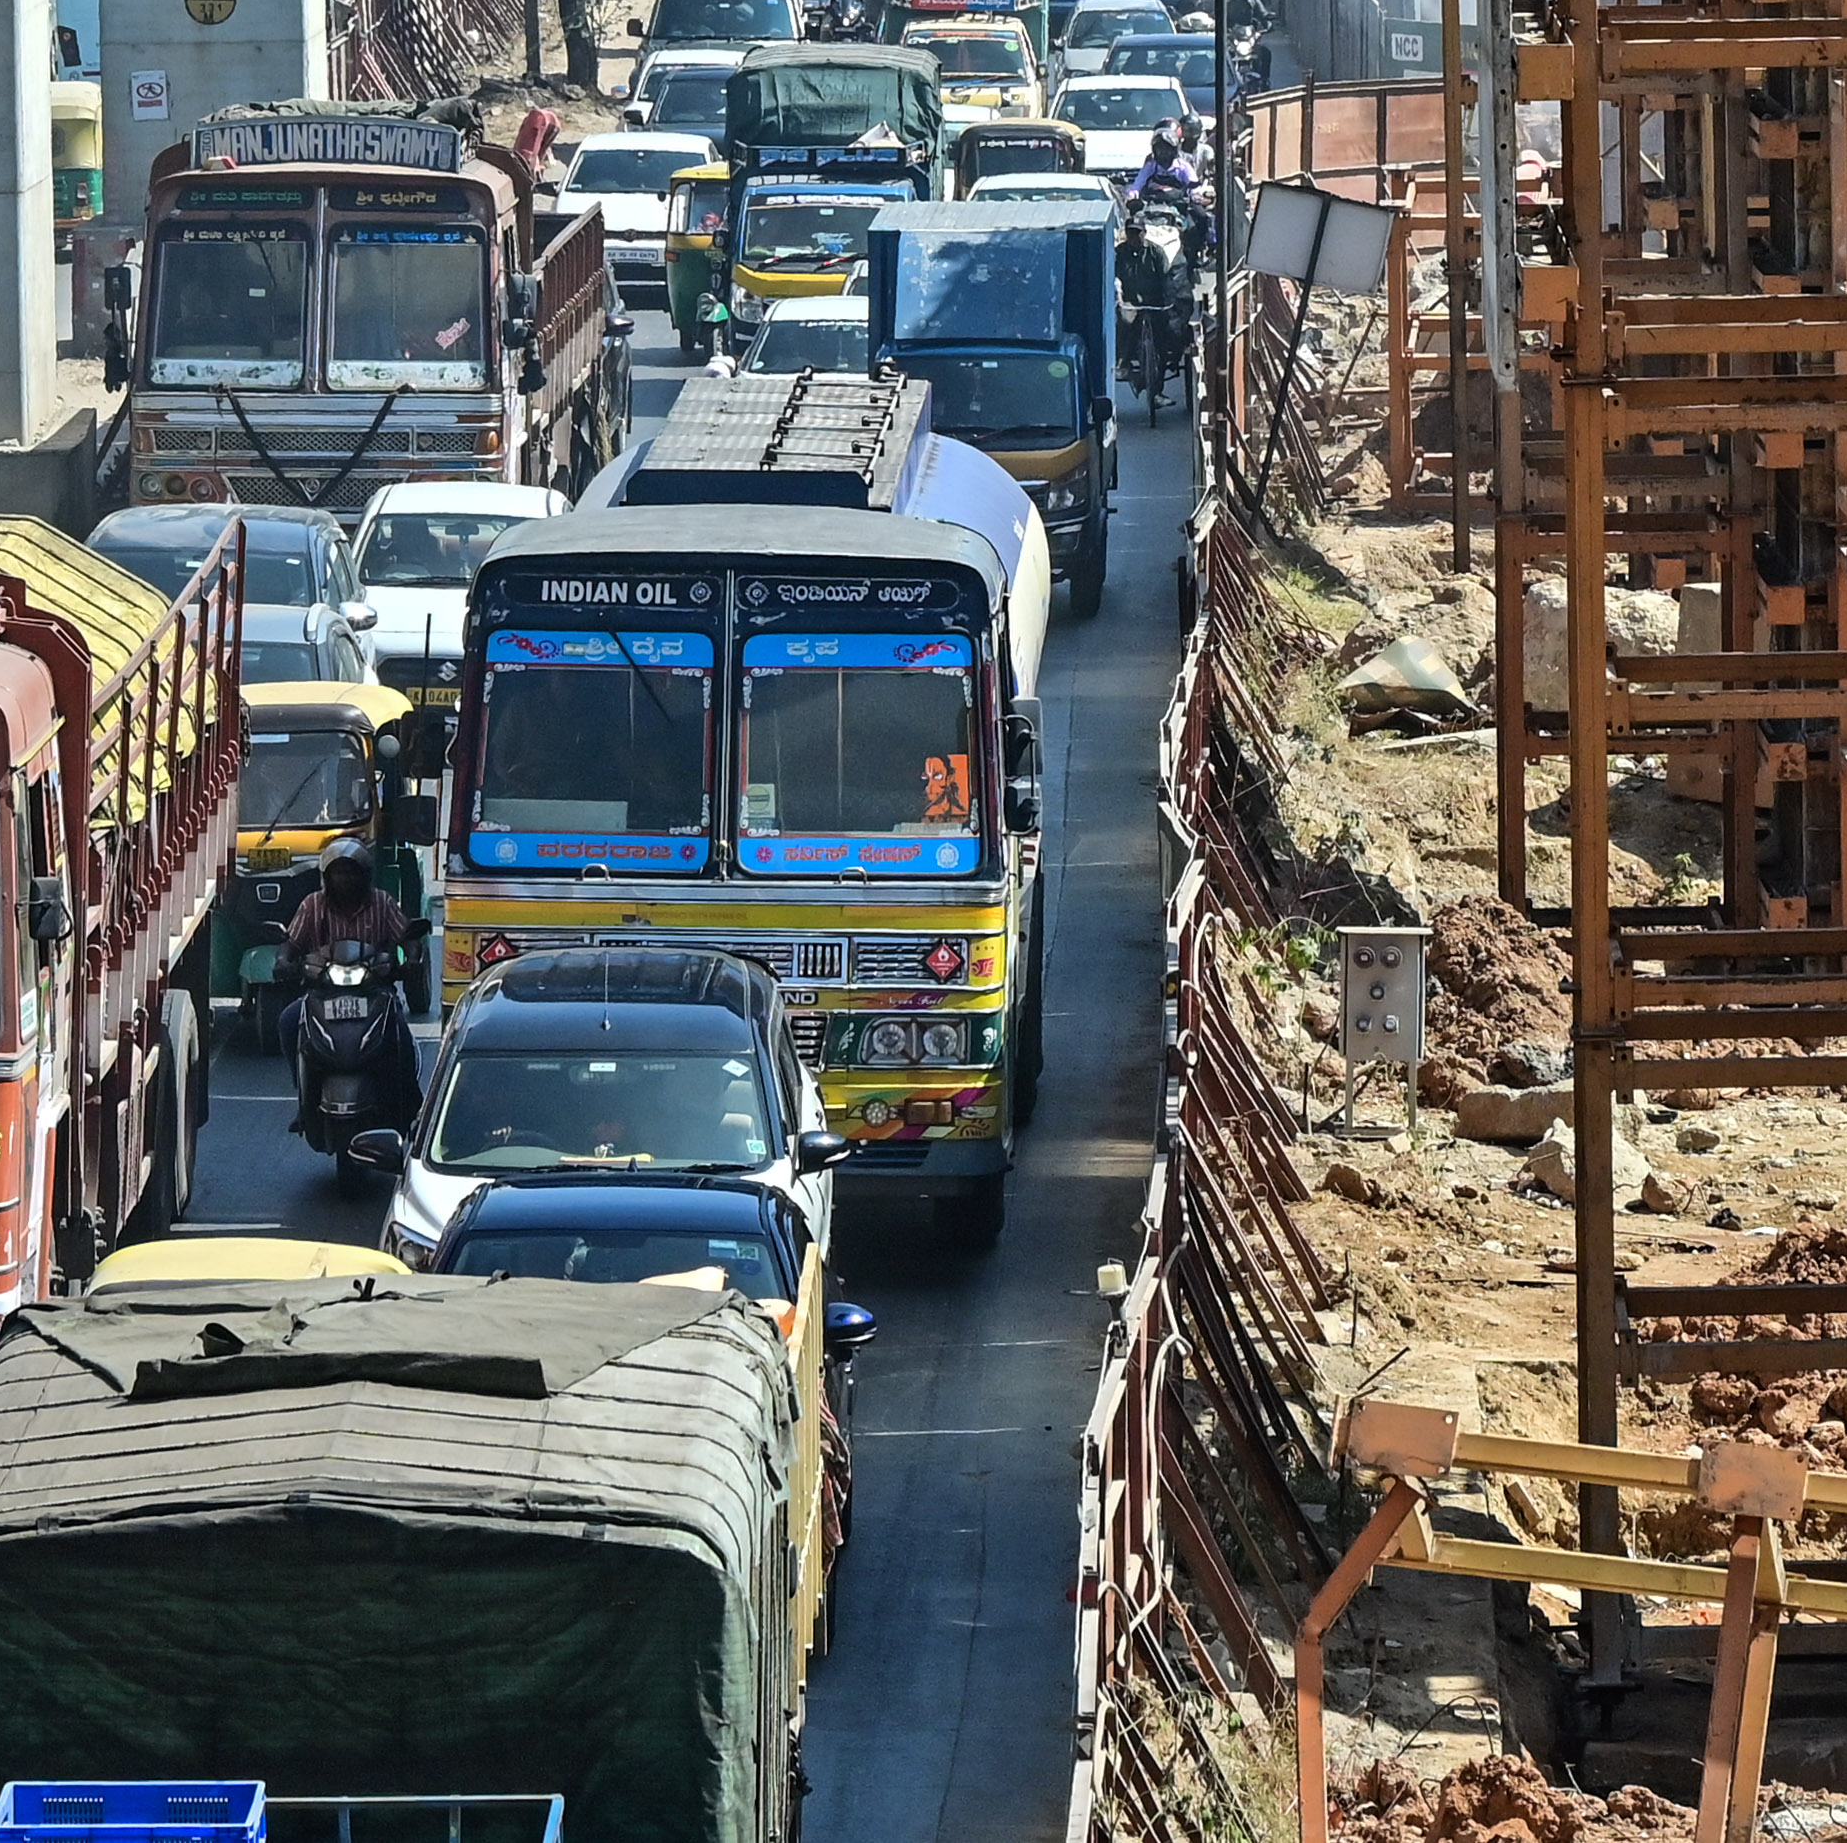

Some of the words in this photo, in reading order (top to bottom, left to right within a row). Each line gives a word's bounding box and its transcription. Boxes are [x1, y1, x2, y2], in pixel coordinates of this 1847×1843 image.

[213, 124, 440, 167] MANJUNATHASWAMY
[541, 580, 629, 604] INDIAN
[635, 582, 677, 605] OIL
[777, 579, 871, 605] ಇಂಡಿಯನ್
[585, 637, 621, 662] ಶ್ರೀ
[632, 636, 684, 663] ದೈವ
[786, 638, 839, 663] ಕೃಪ
